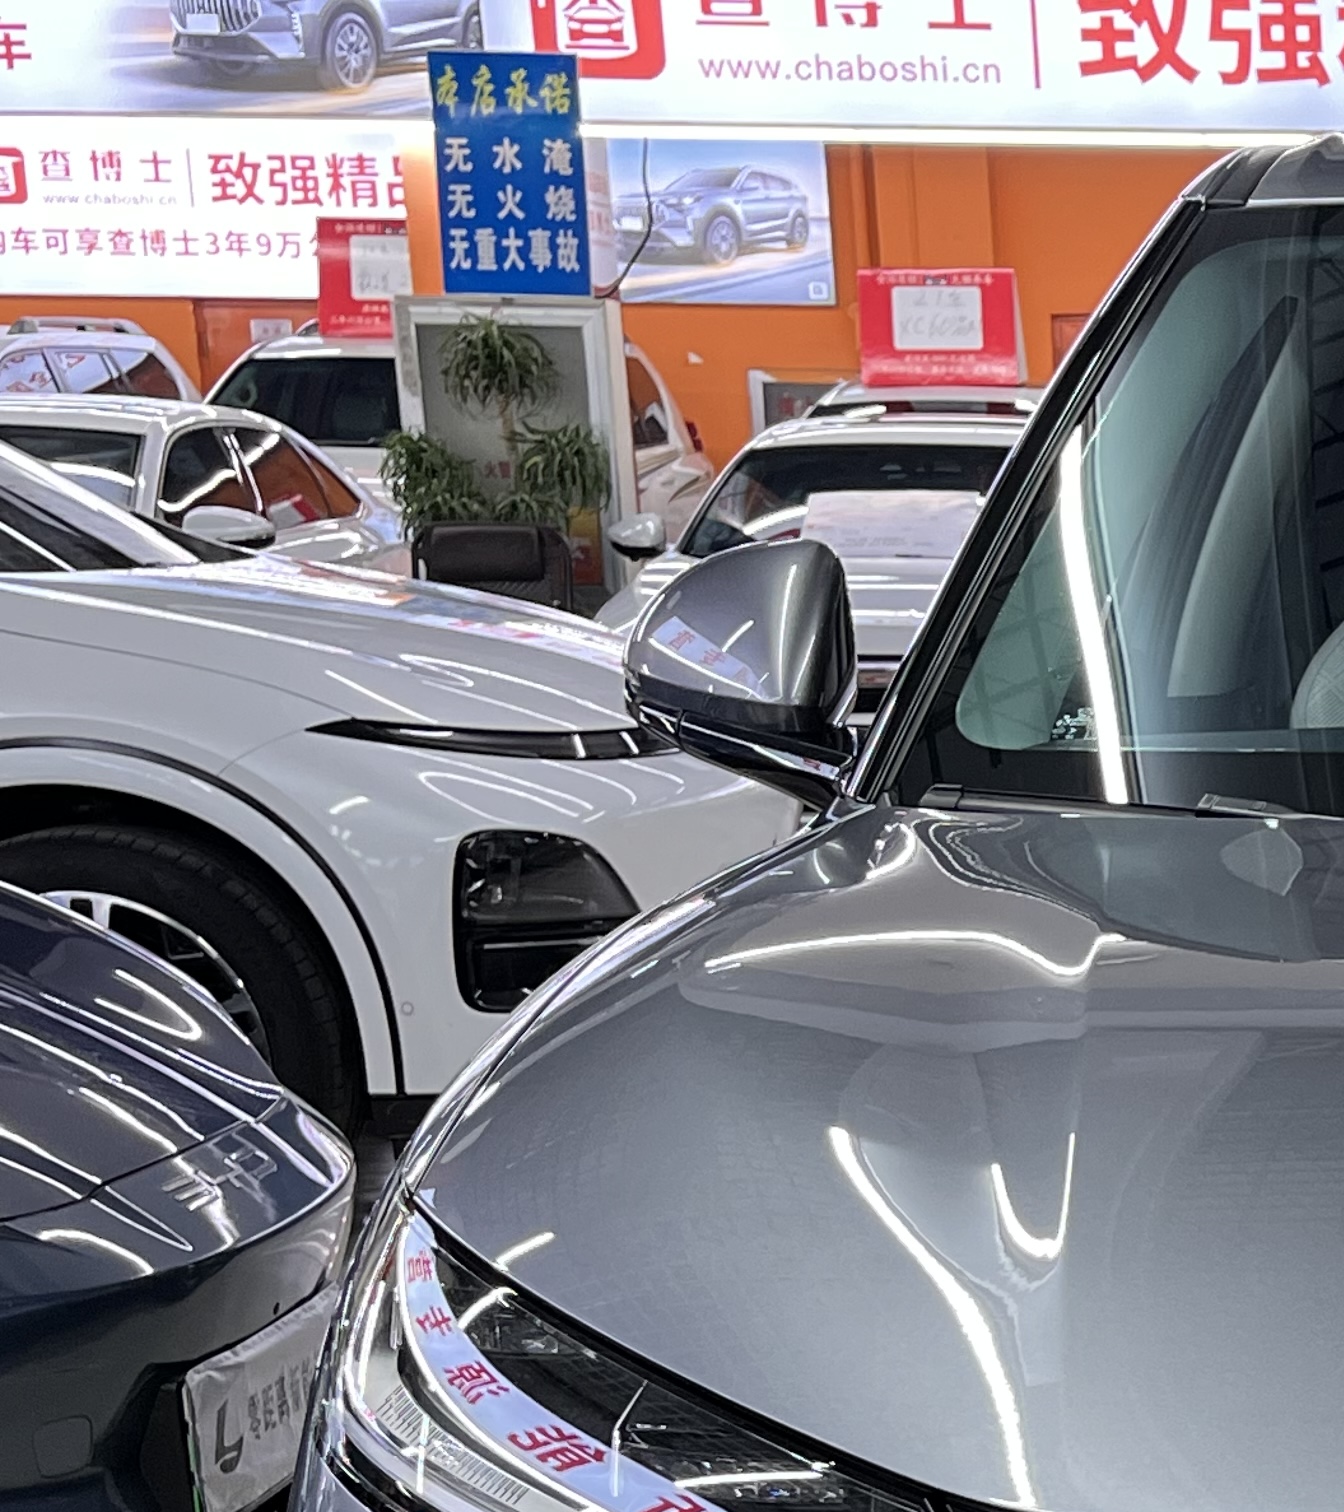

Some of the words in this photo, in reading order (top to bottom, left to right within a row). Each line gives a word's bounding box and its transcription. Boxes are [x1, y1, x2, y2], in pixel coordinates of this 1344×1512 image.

[698, 53, 1001, 84] www.chaboshi.cn
[435, 64, 572, 118] 本店承诺
[39, 150, 173, 182] 查博士
[444, 137, 574, 176] 无水淹
[447, 184, 577, 222] 无火烧
[0, 228, 318, 259] 车可享查博士3年9万
[449, 227, 580, 273] 无重大事故
